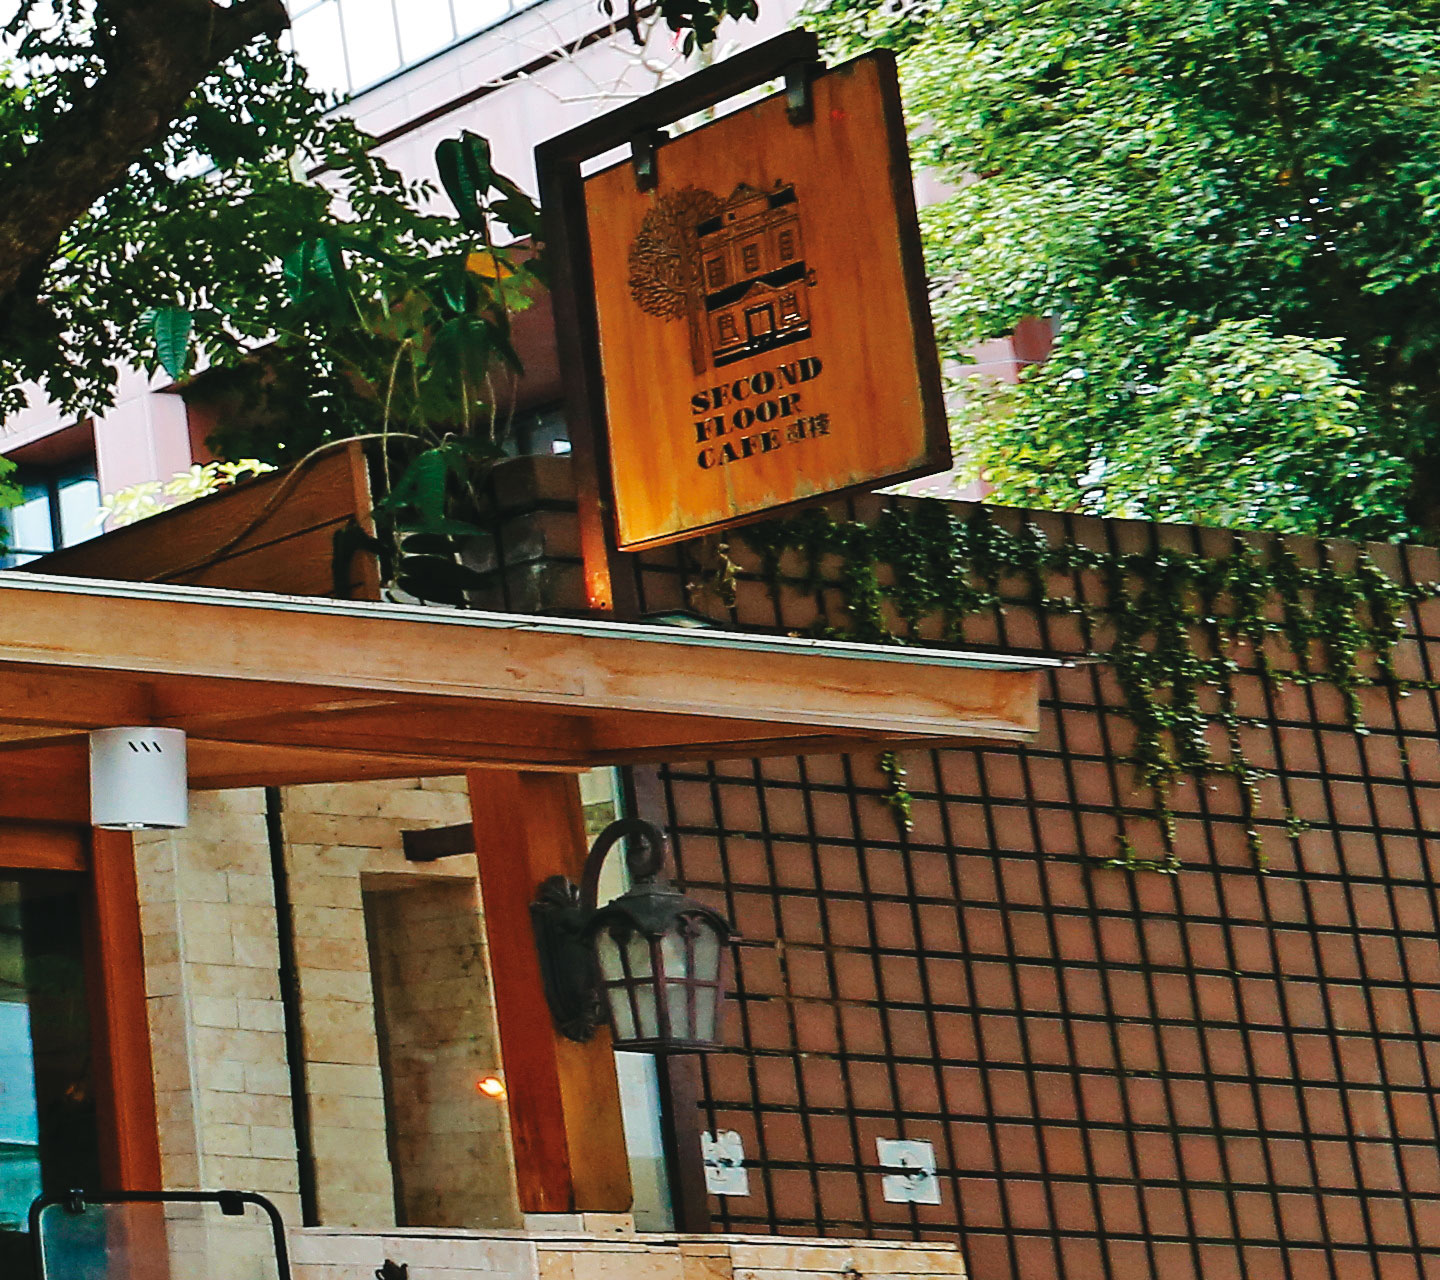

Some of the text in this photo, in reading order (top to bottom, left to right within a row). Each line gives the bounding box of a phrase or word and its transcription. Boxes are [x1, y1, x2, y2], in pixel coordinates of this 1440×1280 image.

[692, 355, 823, 416] SECOND
[695, 392, 802, 444] FLOOR
[697, 430, 781, 471] CAFE
